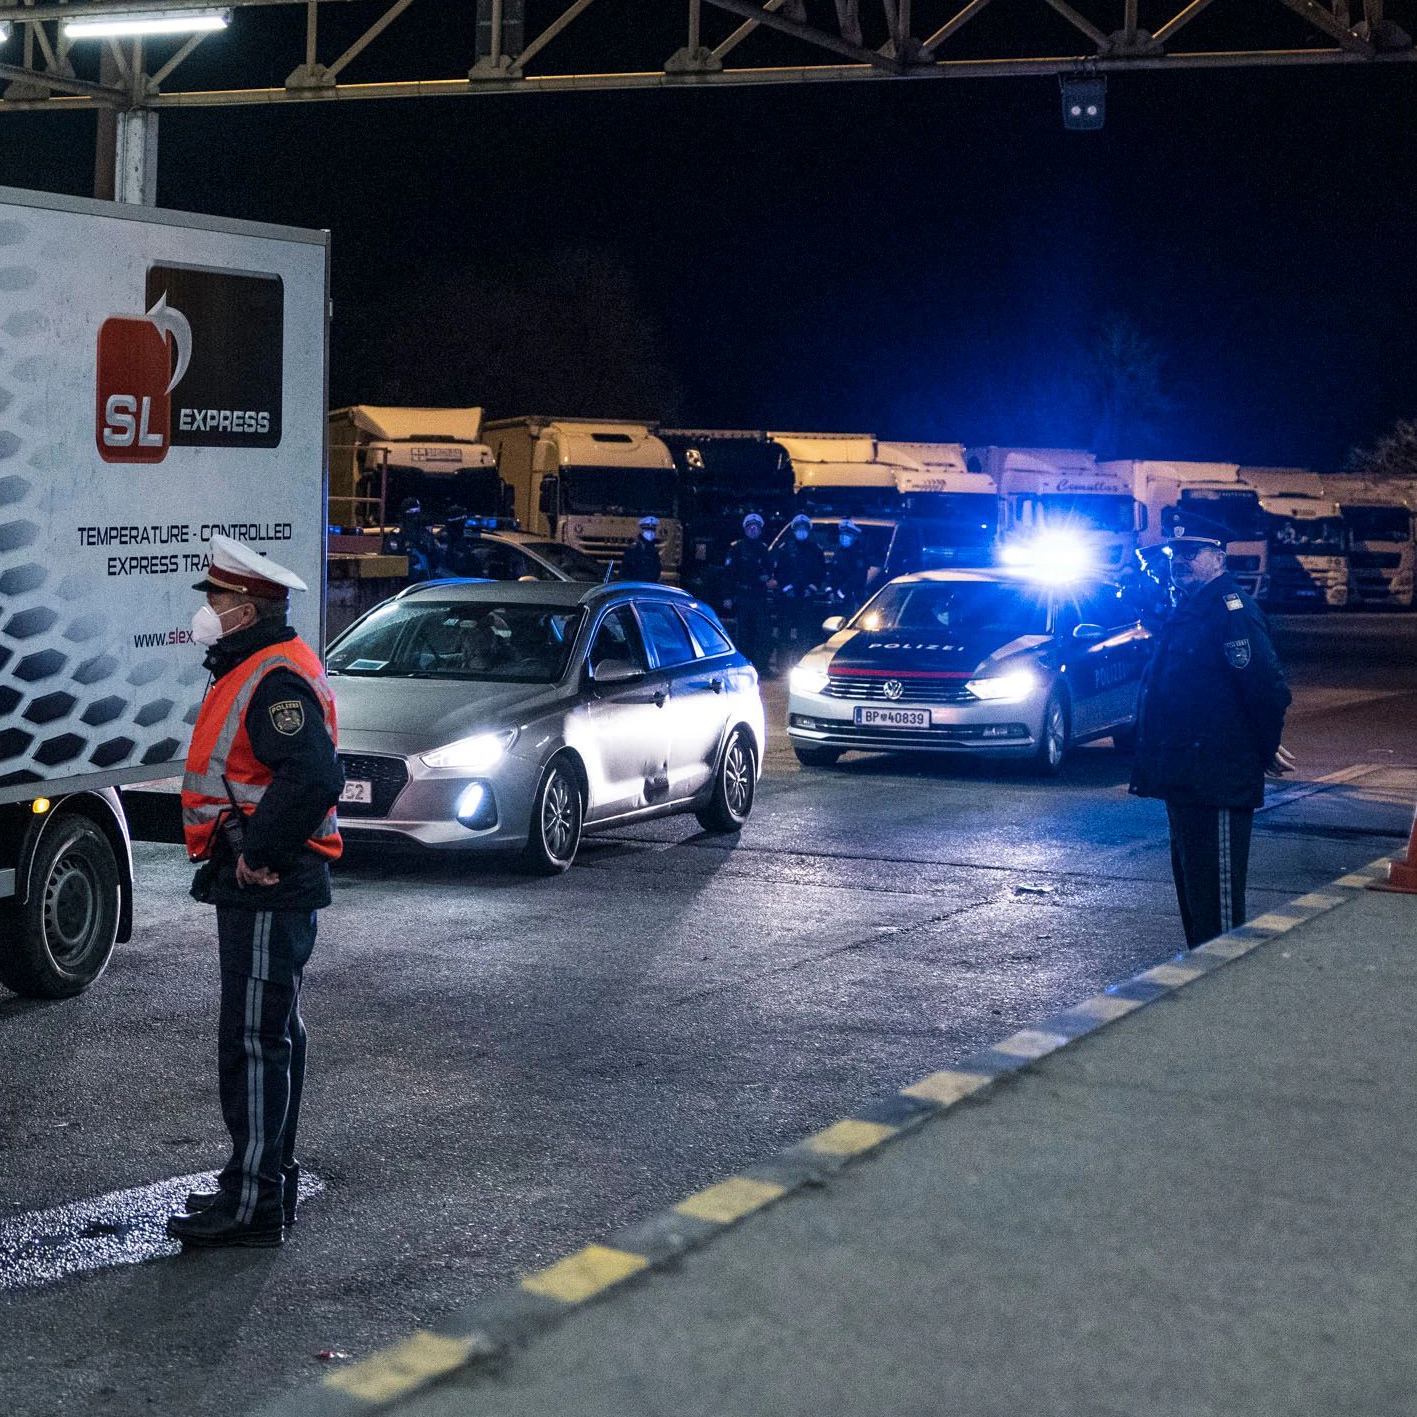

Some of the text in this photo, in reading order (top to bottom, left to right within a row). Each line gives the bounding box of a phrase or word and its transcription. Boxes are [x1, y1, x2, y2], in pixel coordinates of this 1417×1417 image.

[103, 394, 270, 447] SL EXPRESS
[77, 525, 190, 547] TEMPERATURE
[200, 523, 292, 543] CONTROLLED
[107, 554, 179, 576] EXPRESS
[868, 643, 964, 652] POLIZEI
[271, 702, 300, 714] POLIZEI
[865, 710, 924, 725] BP 40839
